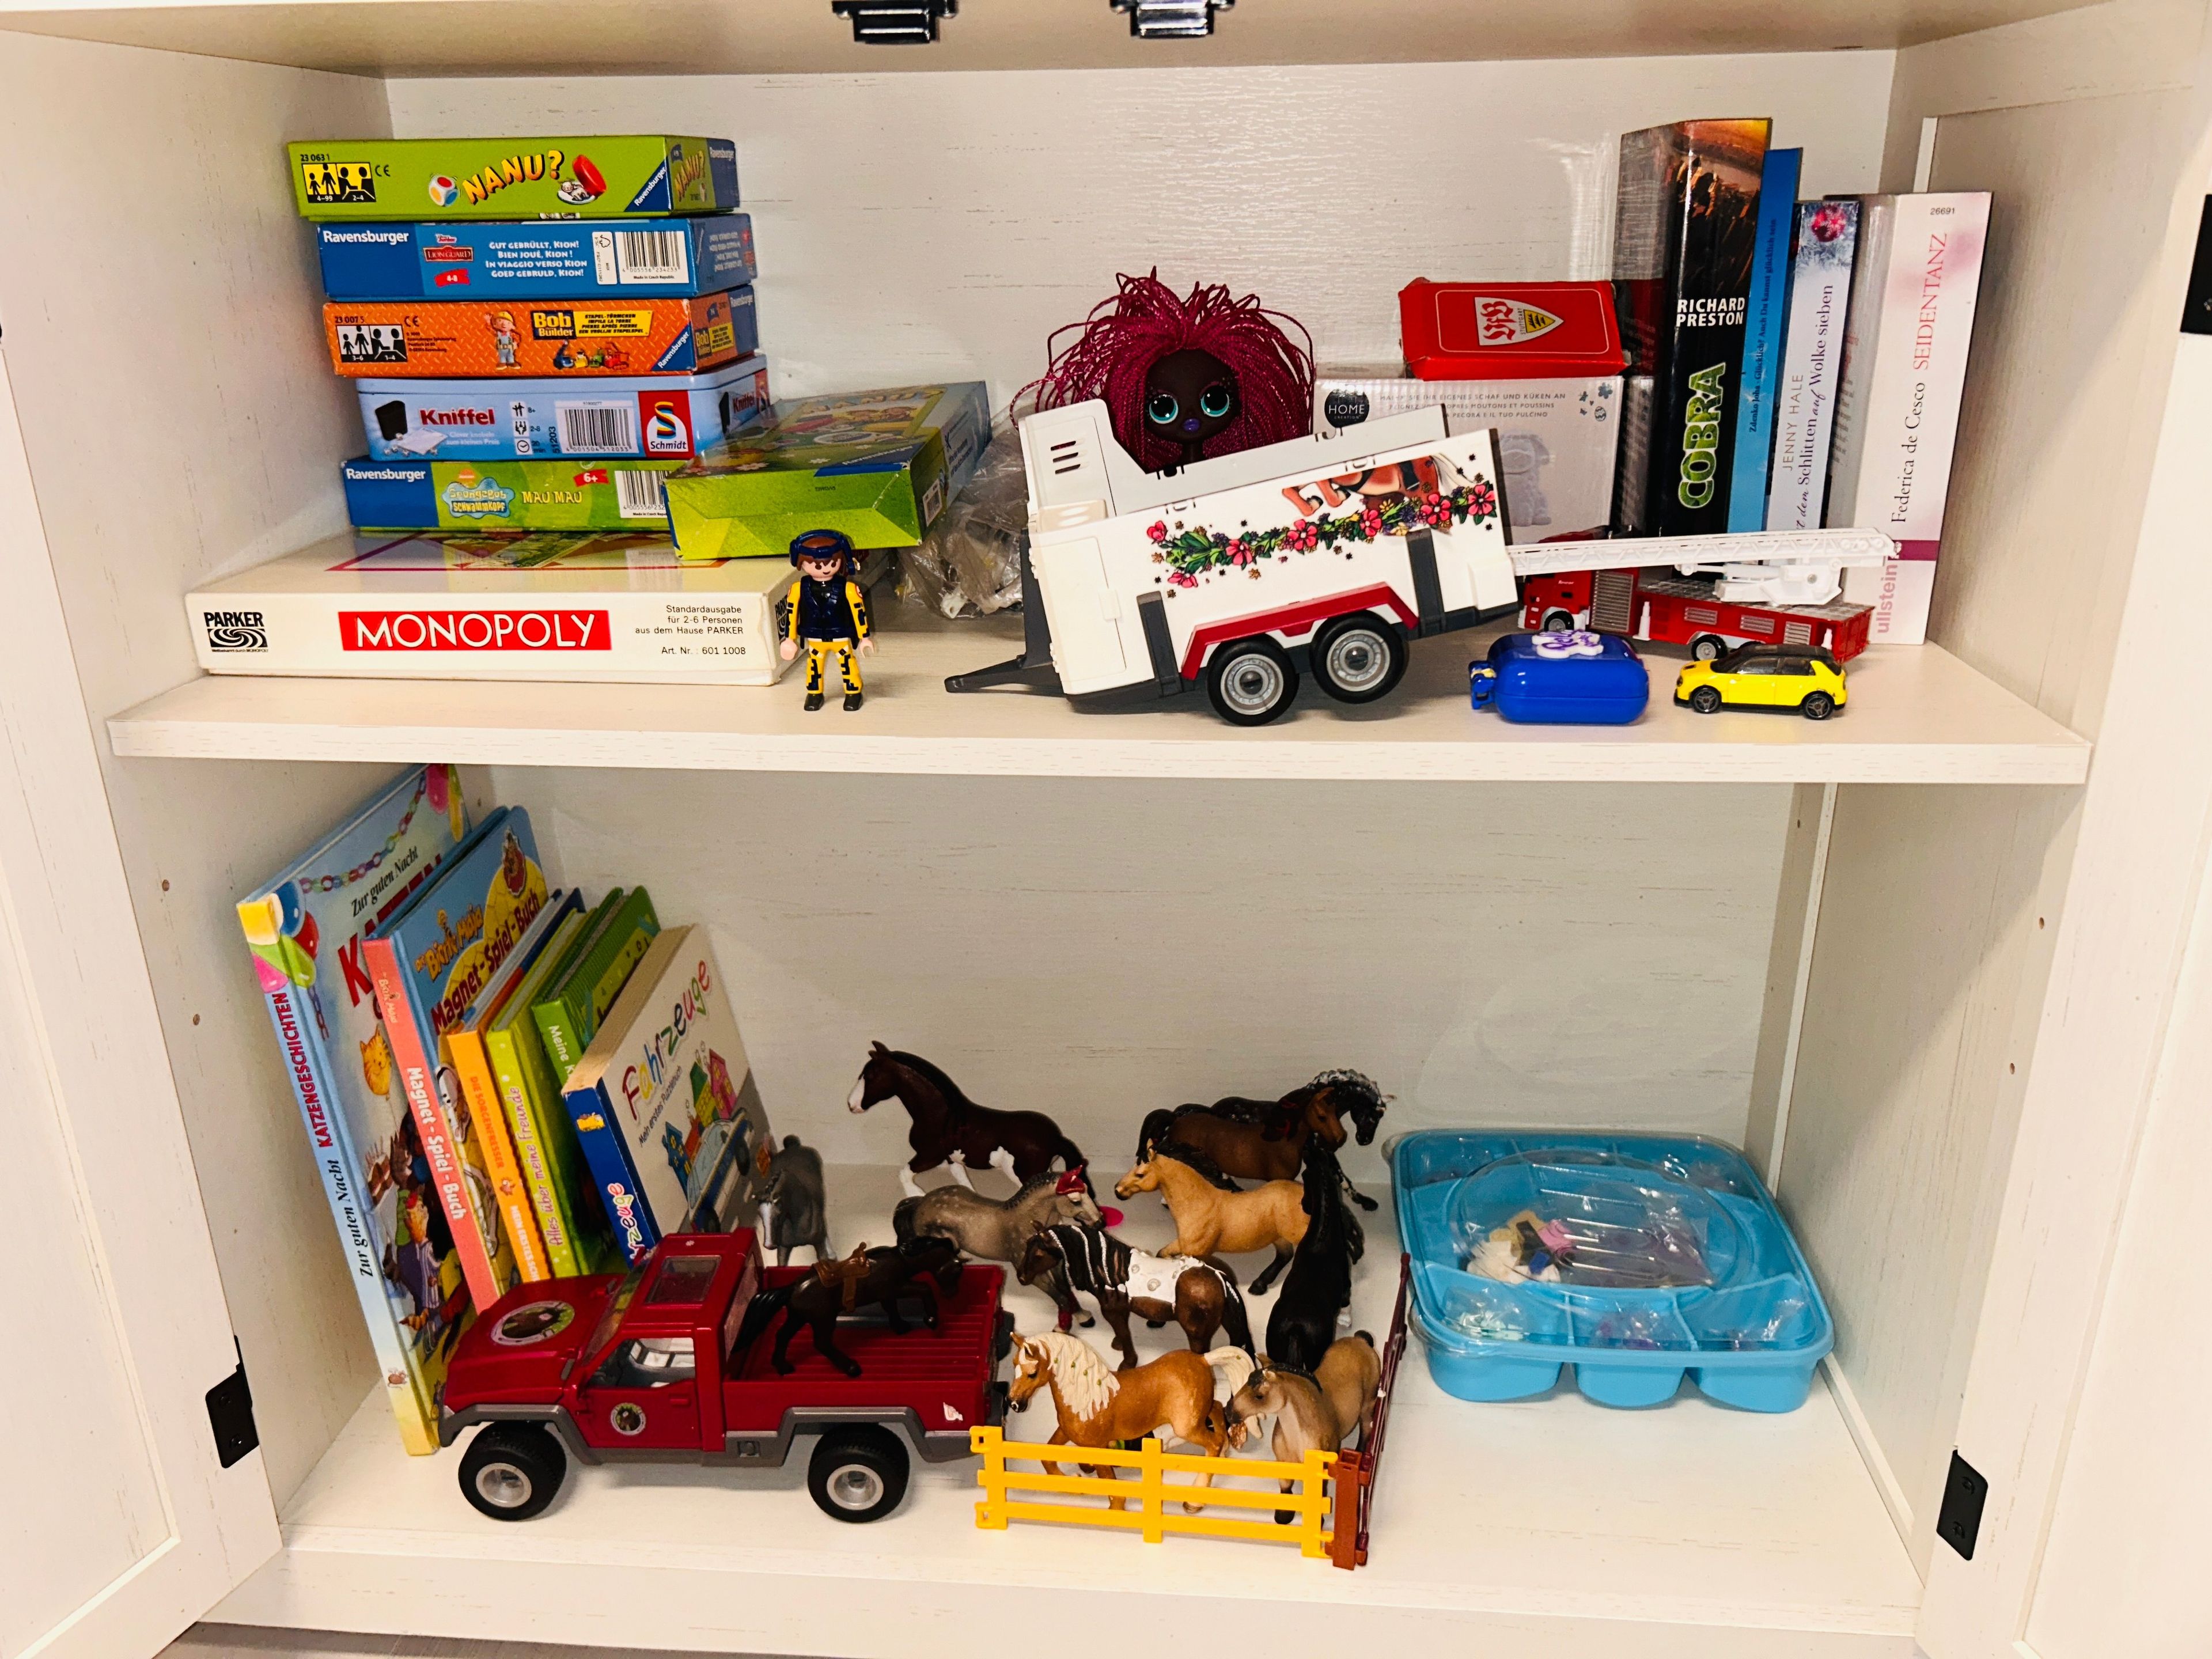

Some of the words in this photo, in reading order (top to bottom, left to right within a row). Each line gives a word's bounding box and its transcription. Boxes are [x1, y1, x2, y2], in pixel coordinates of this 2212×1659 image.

[634, 166, 667, 206] Ravensburger
[1930, 207, 1955, 215] 26691
[323, 230, 409, 245] Ravensburger
[1677, 297, 1745, 312] RICHARD
[1762, 303, 1768, 316] Du
[1817, 285, 1833, 335] sieben
[1913, 232, 1947, 371] SEIDENTANZ
[533, 312, 572, 328] Bob
[539, 328, 573, 337] Builder
[1676, 312, 1744, 327] PRESTON
[657, 331, 690, 369] Ravensburger
[1809, 344, 1825, 388] Wolke
[1328, 404, 1365, 414] HOME
[1752, 385, 1761, 403] Joha
[1789, 374, 1804, 414] HALE
[1813, 388, 1826, 416] auf
[1905, 382, 1925, 429] Cesco
[420, 408, 495, 425] Kniffel
[1749, 403, 1759, 433] Zdenko
[549, 427, 560, 454] 51203
[650, 441, 687, 449] Schmidt
[1678, 362, 1726, 509] COBRA
[1782, 422, 1798, 472] JENNY
[1902, 435, 1918, 454] de
[1798, 419, 1817, 485] Schlitten
[346, 468, 426, 482] Ravensburger
[584, 473, 598, 482] 6+
[522, 491, 550, 503] MAU
[554, 491, 582, 503] MAU
[1797, 488, 1809, 518] dem
[1891, 459, 1915, 522] Federica
[666, 605, 742, 615] Standardausgabe
[1876, 564, 1898, 633] ullstein
[204, 612, 264, 627] PARKER
[356, 613, 595, 647] MONOPOLY
[351, 892, 368, 918] Zur
[370, 872, 395, 905] guten
[394, 846, 419, 878] Nacht
[548, 1025, 569, 1062] Meine
[622, 960, 710, 1122] Fahrzeuge
[272, 992, 333, 1147] KATZENGESCHICHTEN
[470, 1076, 480, 1093] DIE
[638, 1122, 652, 1147] Mein
[649, 1101, 664, 1128] erstes
[526, 1143, 546, 1180] meine
[327, 1158, 349, 1202] Nacht
[540, 1184, 555, 1214] über
[344, 1206, 368, 1248] guten
[545, 1215, 564, 1247] Alles
[359, 1249, 374, 1277] Zur
